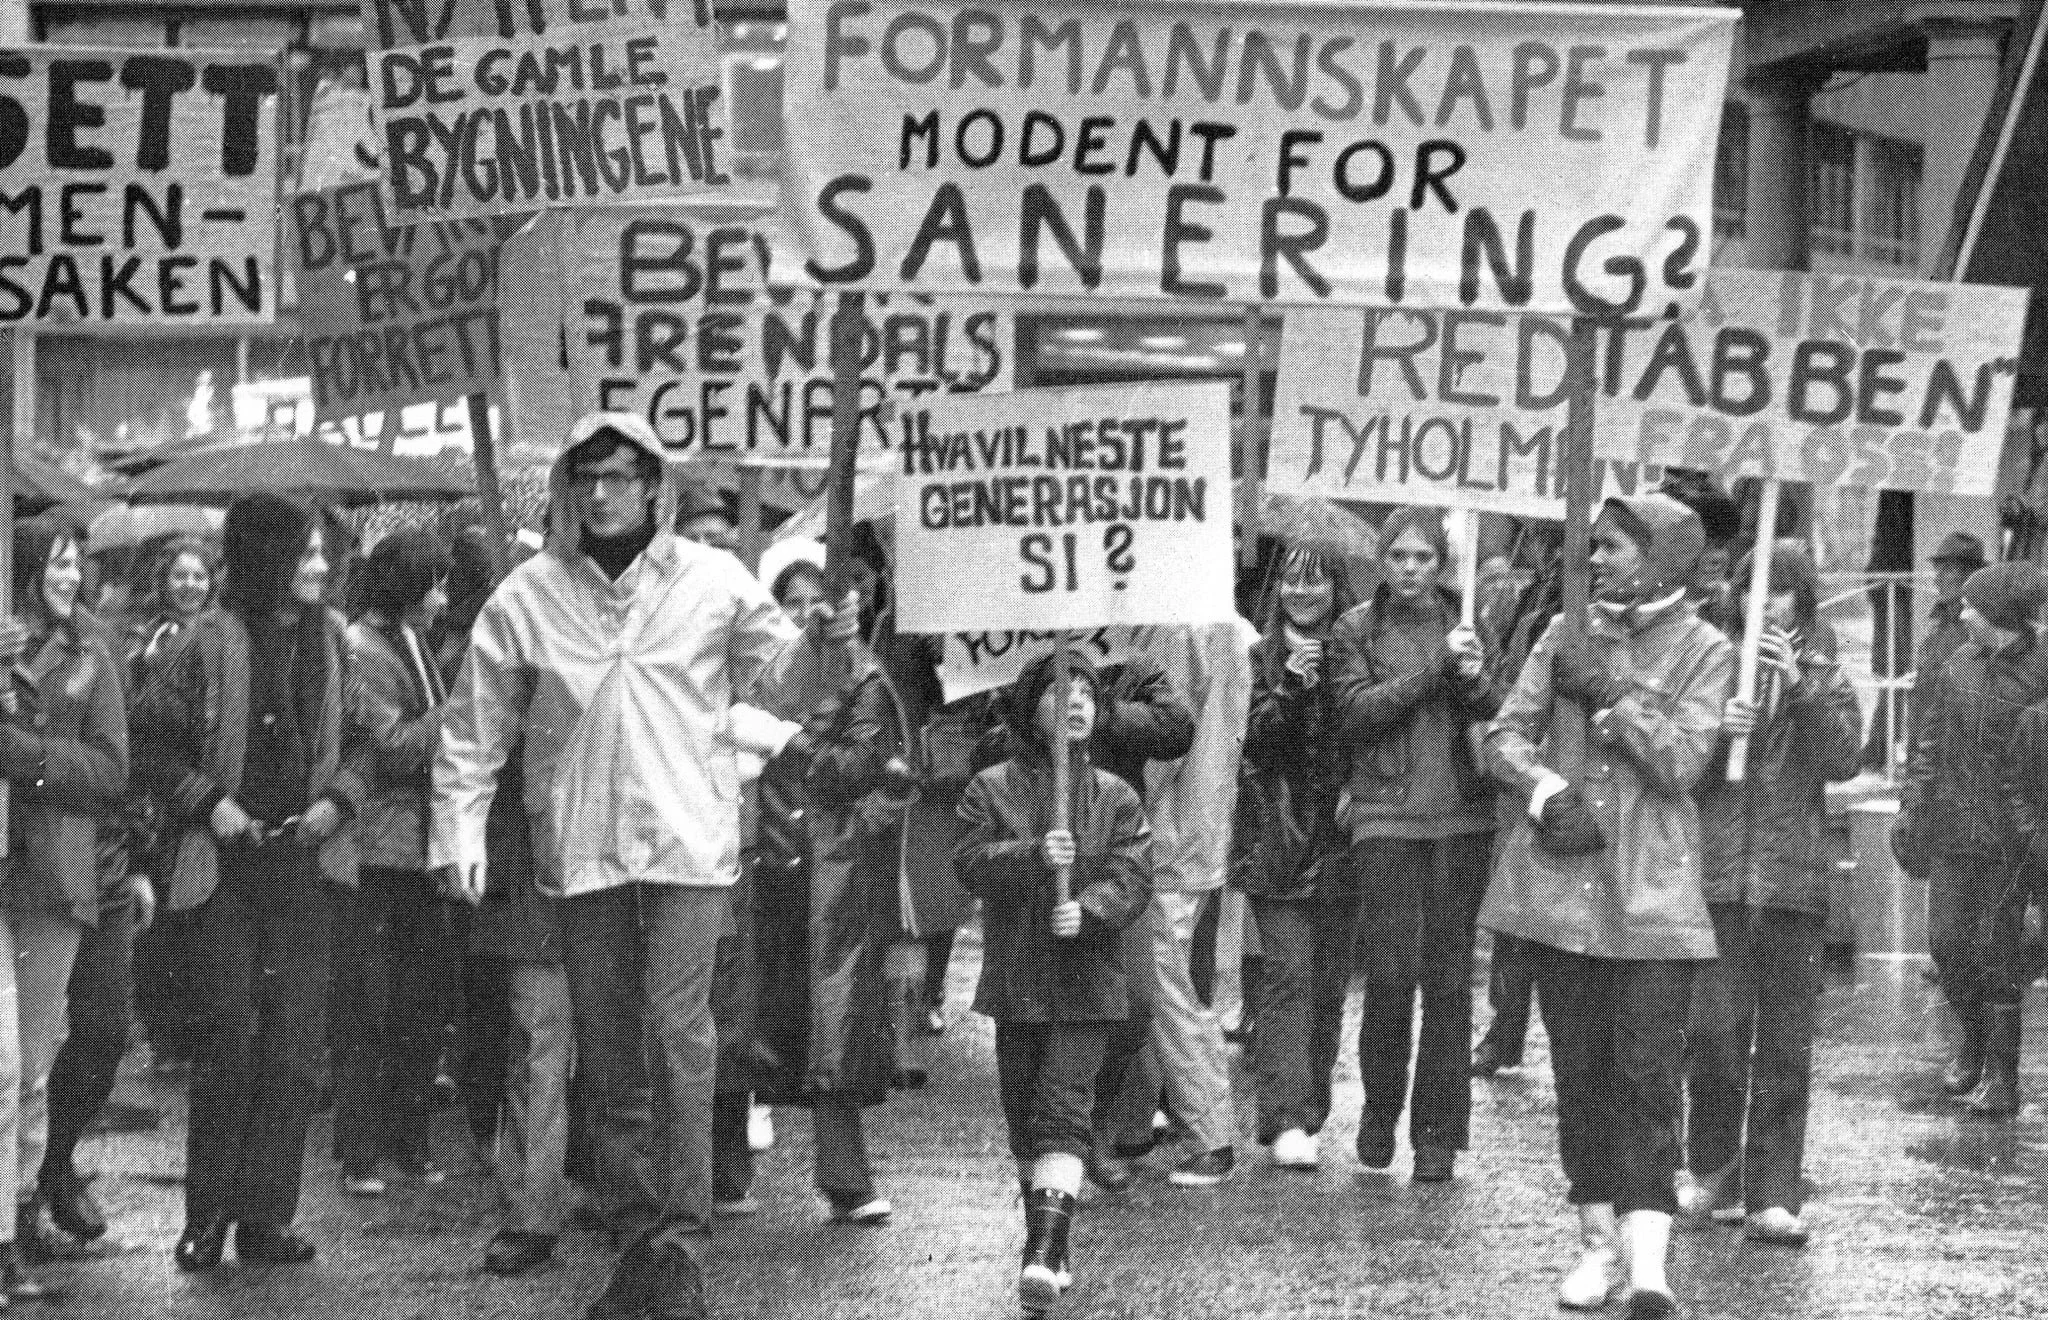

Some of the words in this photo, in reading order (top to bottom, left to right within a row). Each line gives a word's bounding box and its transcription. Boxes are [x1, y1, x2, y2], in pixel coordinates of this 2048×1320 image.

[381, 47, 465, 109] DE
[474, 36, 668, 96] GAMLE
[823, 0, 1688, 150] FORMANNSKAPET
[386, 86, 731, 211] BYGNINGENE
[899, 108, 1237, 181] MODENT
[1276, 130, 1467, 214] FOR
[804, 174, 1702, 320] SANERING?
[1046, 416, 1189, 473] NESTE
[919, 475, 1208, 531] GENERASJON
